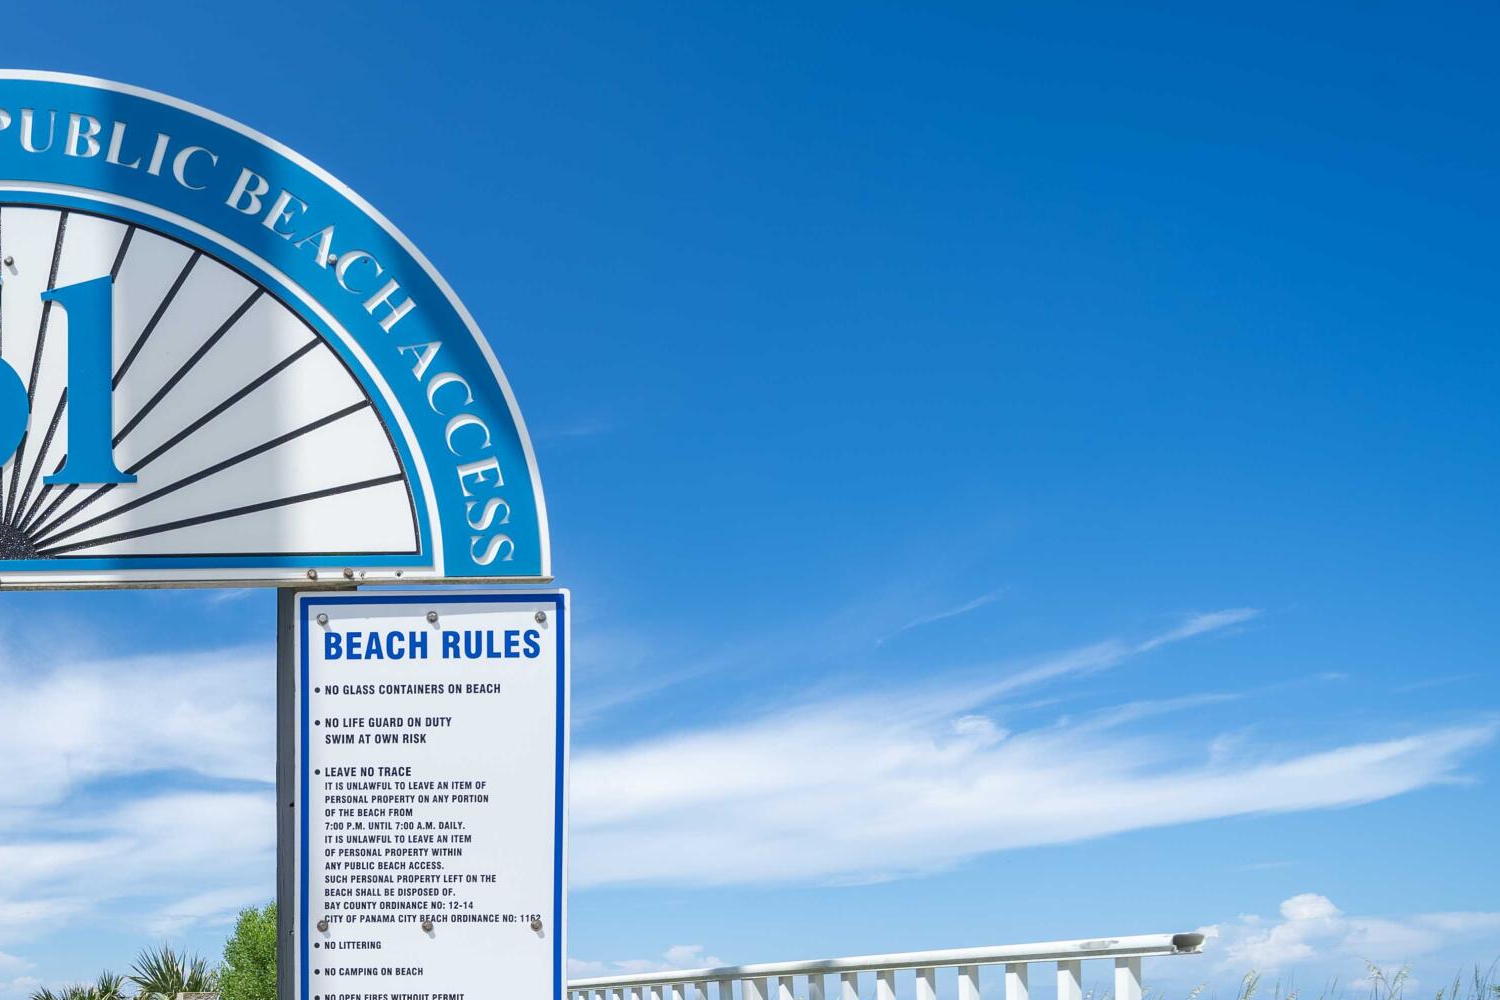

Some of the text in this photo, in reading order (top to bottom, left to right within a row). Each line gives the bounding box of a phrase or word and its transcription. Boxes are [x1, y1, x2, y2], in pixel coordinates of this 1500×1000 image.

[224, 167, 419, 334] BEACH
[397, 340, 515, 567] ACCESS
[325, 630, 540, 660] BEACH RULES
[325, 684, 500, 695] NO GLASS CONTAINERS ON BEACH
[325, 717, 451, 727] NO LIFE GUARD ON DUTY
[326, 734, 426, 744] SWIM AT OWN RISK
[325, 767, 411, 777] LEAVE NO TRACE
[325, 782, 332, 790] IT
[336, 782, 343, 790] IS
[347, 782, 392, 790] UNLAWFUL
[395, 782, 405, 790] TO
[409, 782, 434, 790] LEAVE
[476, 781, 486, 789] OF
[372, 795, 415, 803] PROPERTY
[418, 795, 429, 803] ON
[432, 795, 449, 803] ANY
[452, 795, 488, 803] PORTION
[325, 809, 335, 817] OF
[389, 808, 412, 816] FROM
[339, 941, 381, 949] LITTERING
[325, 968, 336, 976] NO
[339, 968, 378, 976] CAMPING
